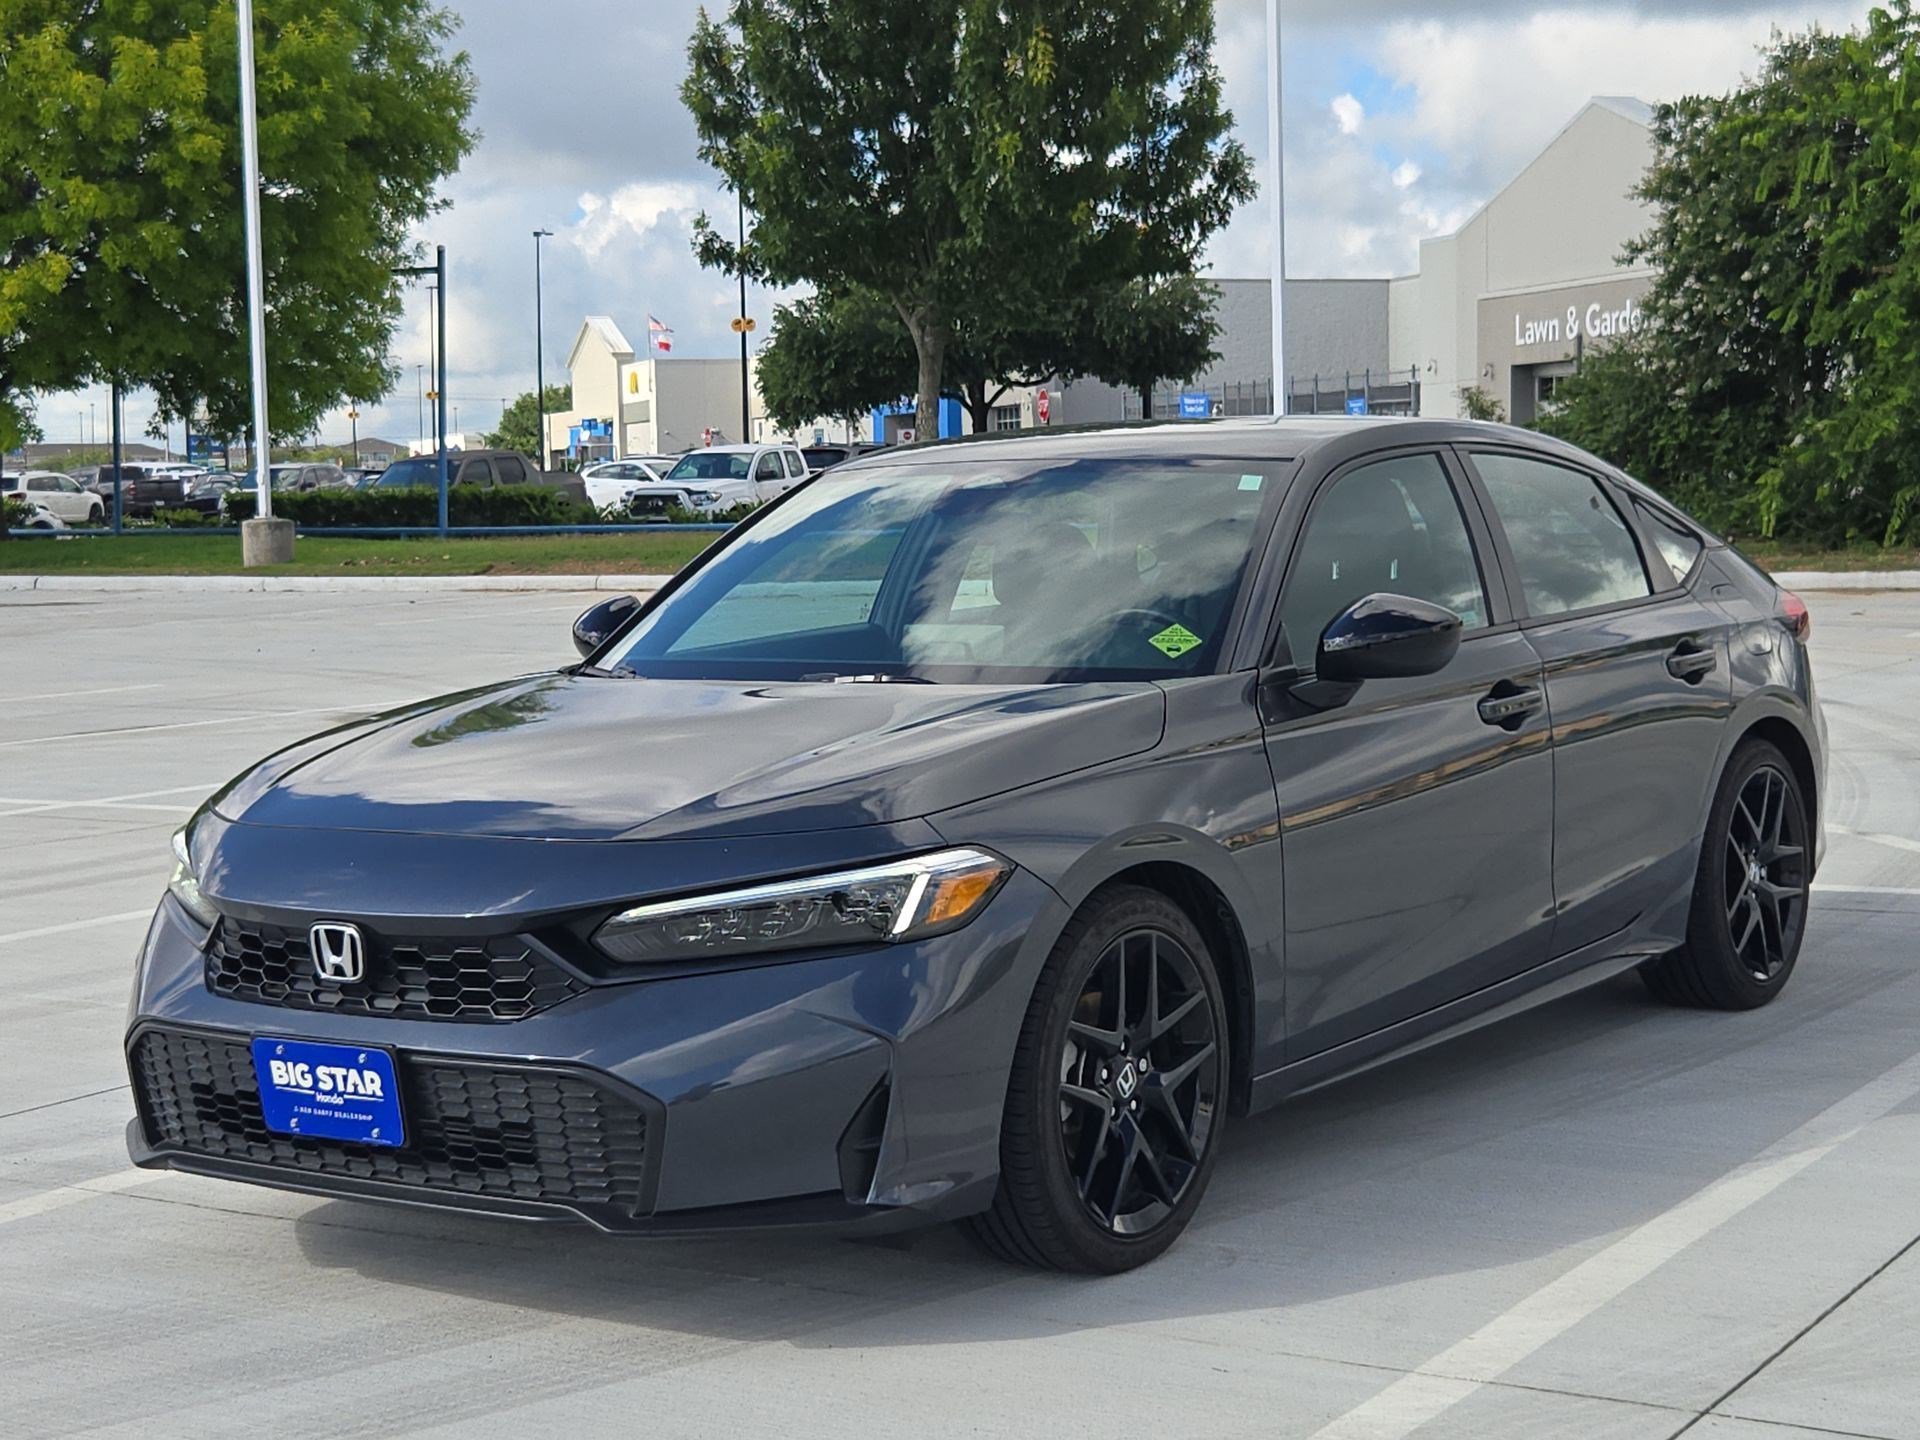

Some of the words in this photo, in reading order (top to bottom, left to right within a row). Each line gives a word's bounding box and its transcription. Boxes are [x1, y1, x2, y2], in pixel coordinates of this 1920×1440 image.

[1515, 313, 1559, 346] Lawn
[1565, 305, 1579, 340] &
[1585, 299, 1647, 337] Garde
[269, 1059, 313, 1088] BIG
[315, 1065, 384, 1097] STAR
